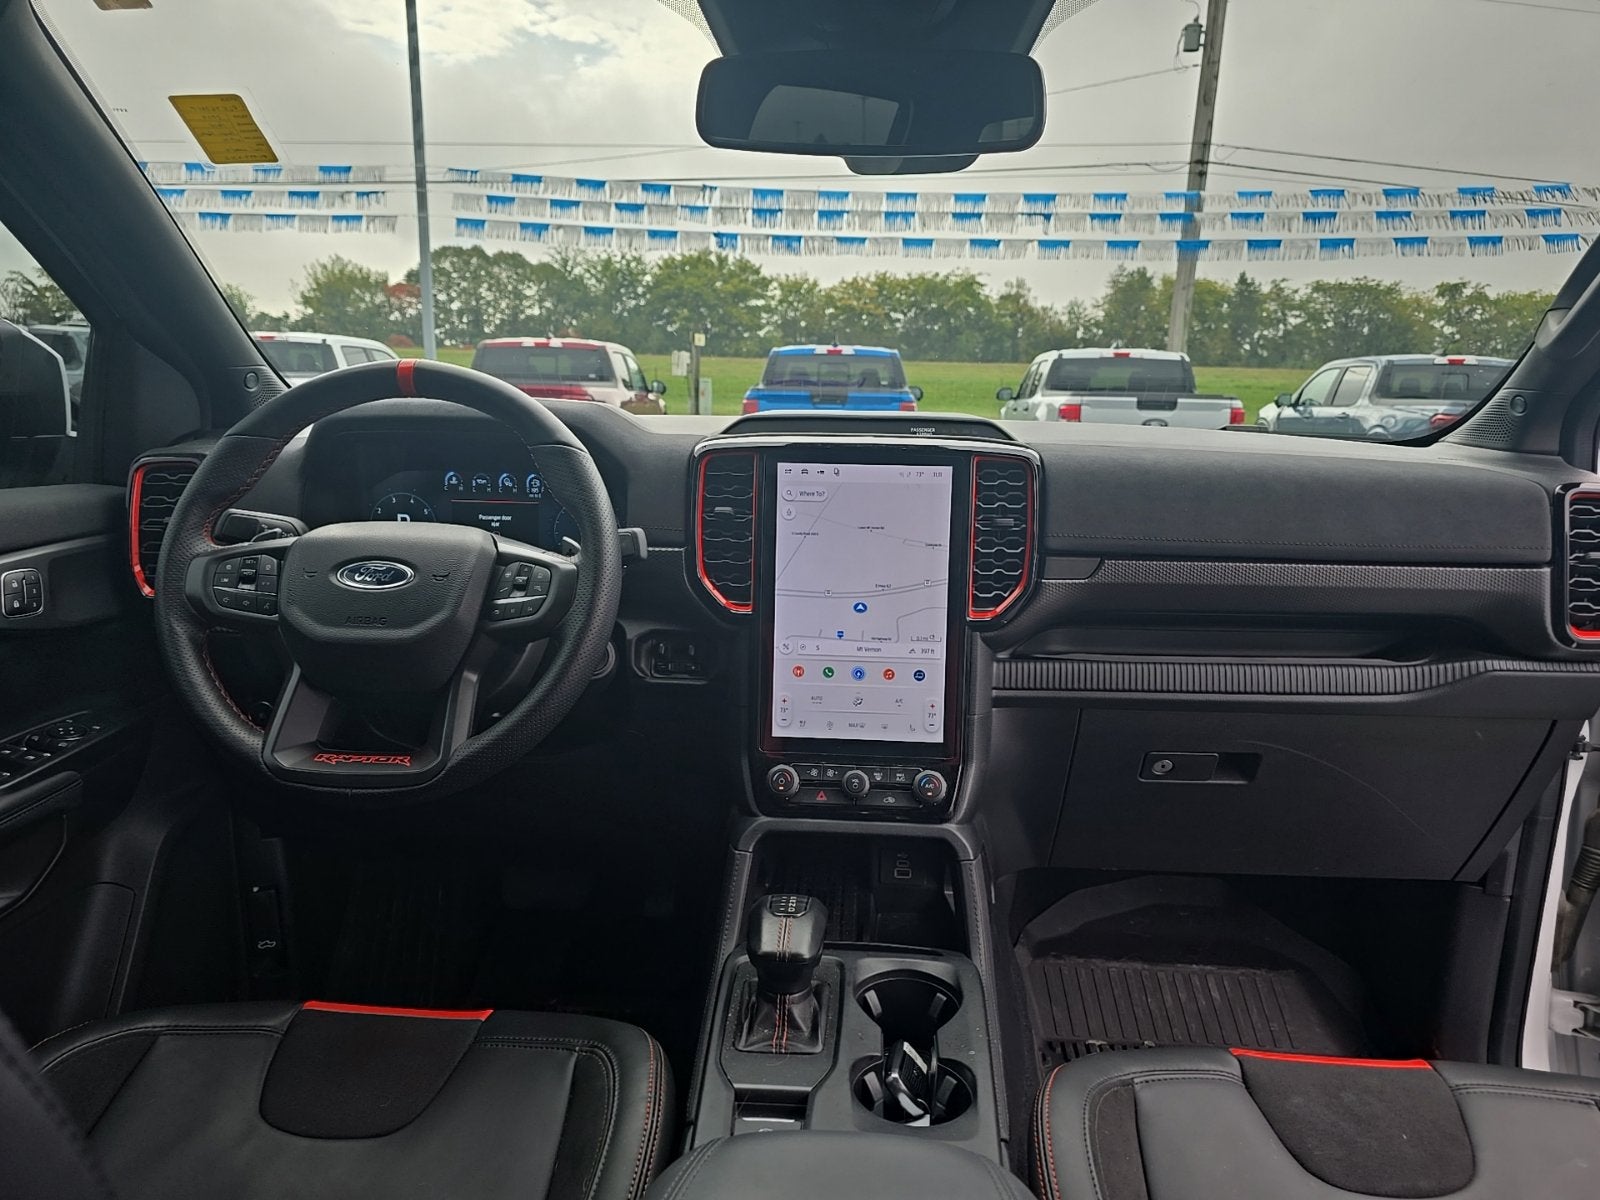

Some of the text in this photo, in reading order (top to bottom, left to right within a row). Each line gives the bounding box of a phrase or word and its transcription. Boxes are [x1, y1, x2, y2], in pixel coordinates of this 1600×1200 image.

[354, 566, 395, 582] Ford
[344, 615, 388, 626] AIRBAG
[314, 753, 411, 767] RAPTOR
